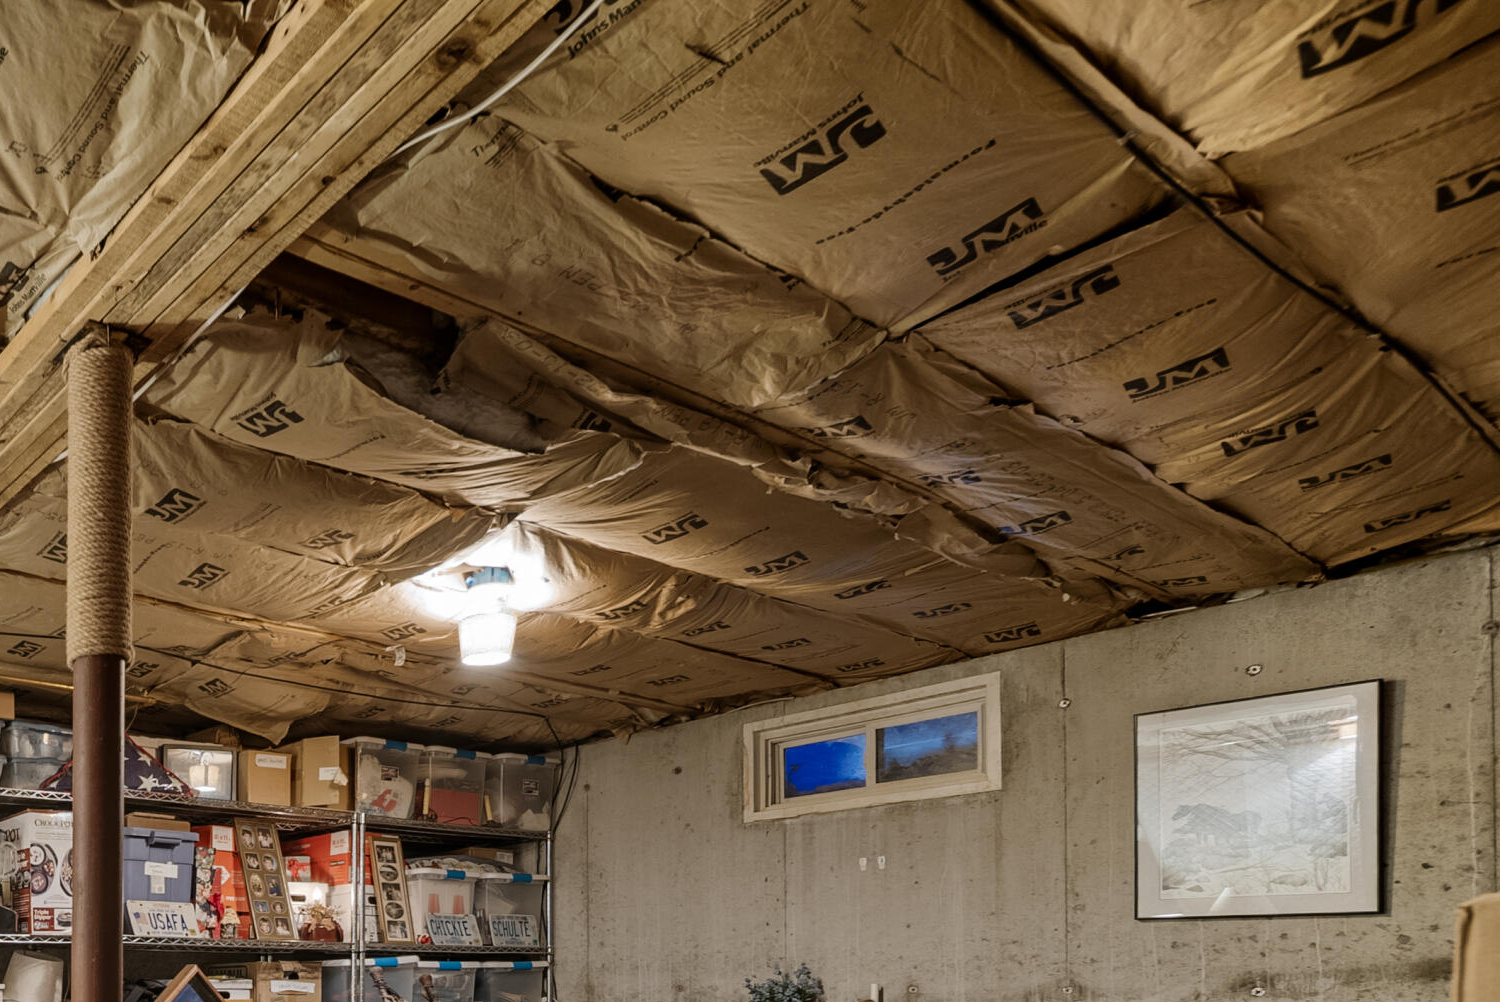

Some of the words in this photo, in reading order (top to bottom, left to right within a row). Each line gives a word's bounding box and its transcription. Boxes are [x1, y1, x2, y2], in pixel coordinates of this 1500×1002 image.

[566, 18, 607, 60] Johns
[717, 50, 745, 79] and
[670, 75, 716, 114] Sound
[621, 108, 669, 142] Control
[759, 103, 887, 195] JM
[927, 197, 1045, 276] JM
[1007, 264, 1121, 330] JM
[1123, 346, 1230, 399] JM
[237, 399, 305, 438] JM
[1221, 409, 1319, 457] JM
[1299, 453, 1392, 490] JM
[144, 487, 202, 523] JM
[1364, 500, 1451, 533] JM
[644, 511, 709, 545] JM
[179, 562, 227, 590] JM
[744, 550, 811, 577] JM
[381, 621, 428, 641] JM
[985, 622, 1042, 644] JM
[7, 639, 44, 658] JM
[198, 677, 230, 697] JM
[33, 908, 49, 916] Triple
[148, 911, 189, 932] USAFA
[429, 918, 472, 937] CHICKIE
[491, 919, 531, 938] SCHULTE
